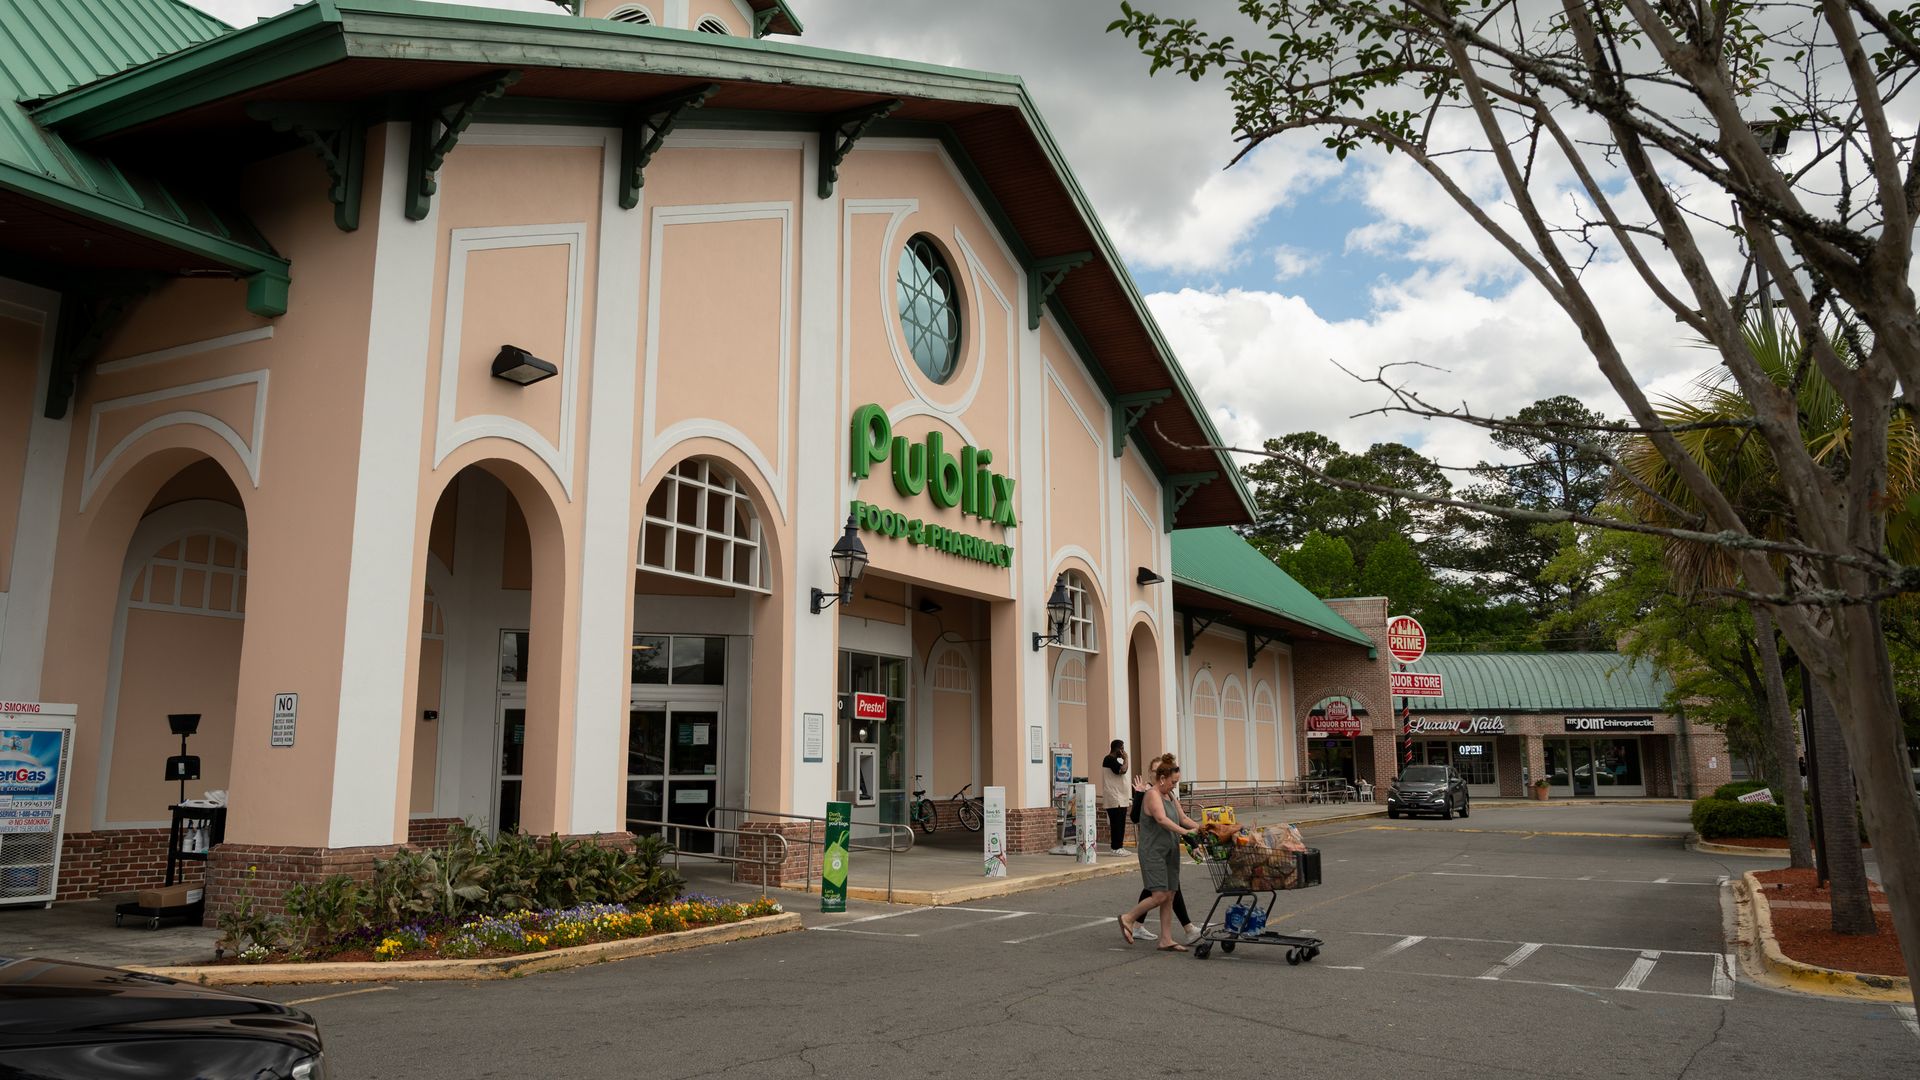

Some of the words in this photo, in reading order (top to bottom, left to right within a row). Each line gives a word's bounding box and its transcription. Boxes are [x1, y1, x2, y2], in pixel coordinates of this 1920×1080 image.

[851, 403, 1017, 528] Publix
[851, 500, 909, 538] FOOD
[908, 519, 925, 544] &
[925, 523, 1014, 568] PHARMACY
[1390, 637, 1422, 650] PRIME
[1414, 675, 1440, 688] STORE
[4, 702, 40, 713] SMOKING
[278, 697, 293, 711] NO
[858, 699, 885, 713] Presto!
[1316, 720, 1339, 728] LIQUOR
[1340, 720, 1360, 728] STORE
[1409, 716, 1460, 734] Luxury
[1460, 715, 1505, 734] Nails
[1576, 718, 1605, 730] JOINT
[1459, 745, 1482, 755] OPEN
